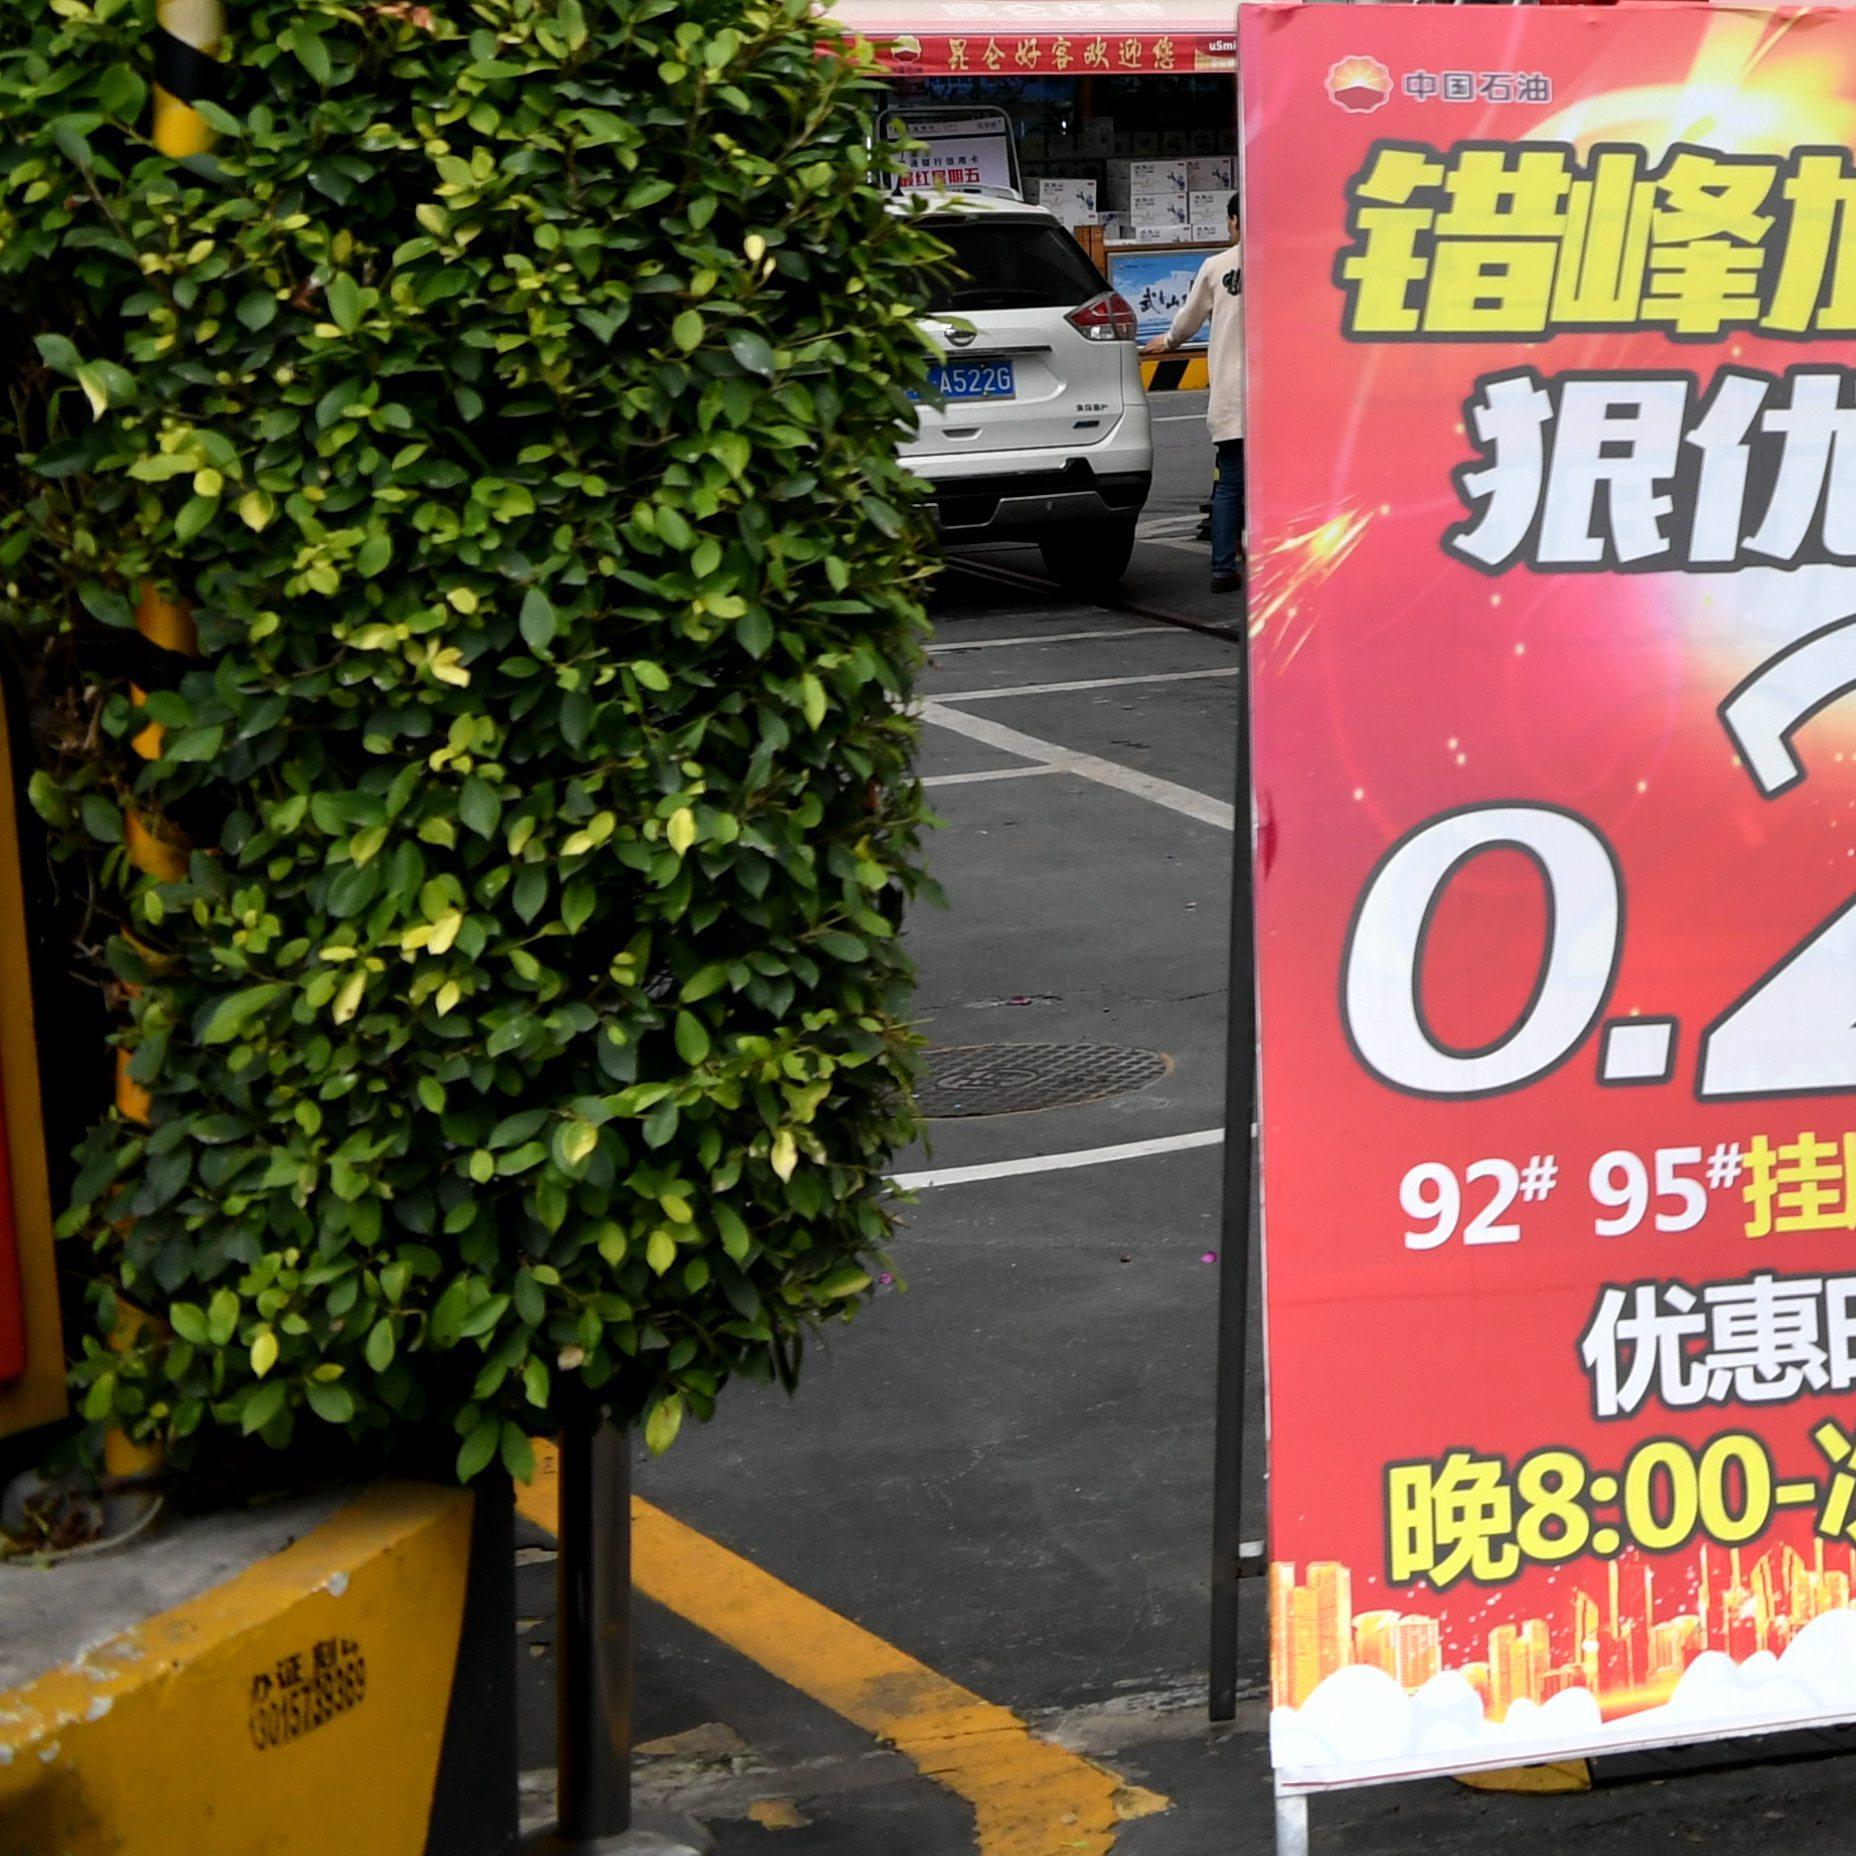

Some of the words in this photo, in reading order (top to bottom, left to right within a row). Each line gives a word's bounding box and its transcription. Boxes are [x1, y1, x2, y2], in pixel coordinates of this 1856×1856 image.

[1208, 40, 1237, 52] uSmi
[1402, 70, 1553, 105] 中国石油
[1400, 1152, 1556, 1249] 92#
